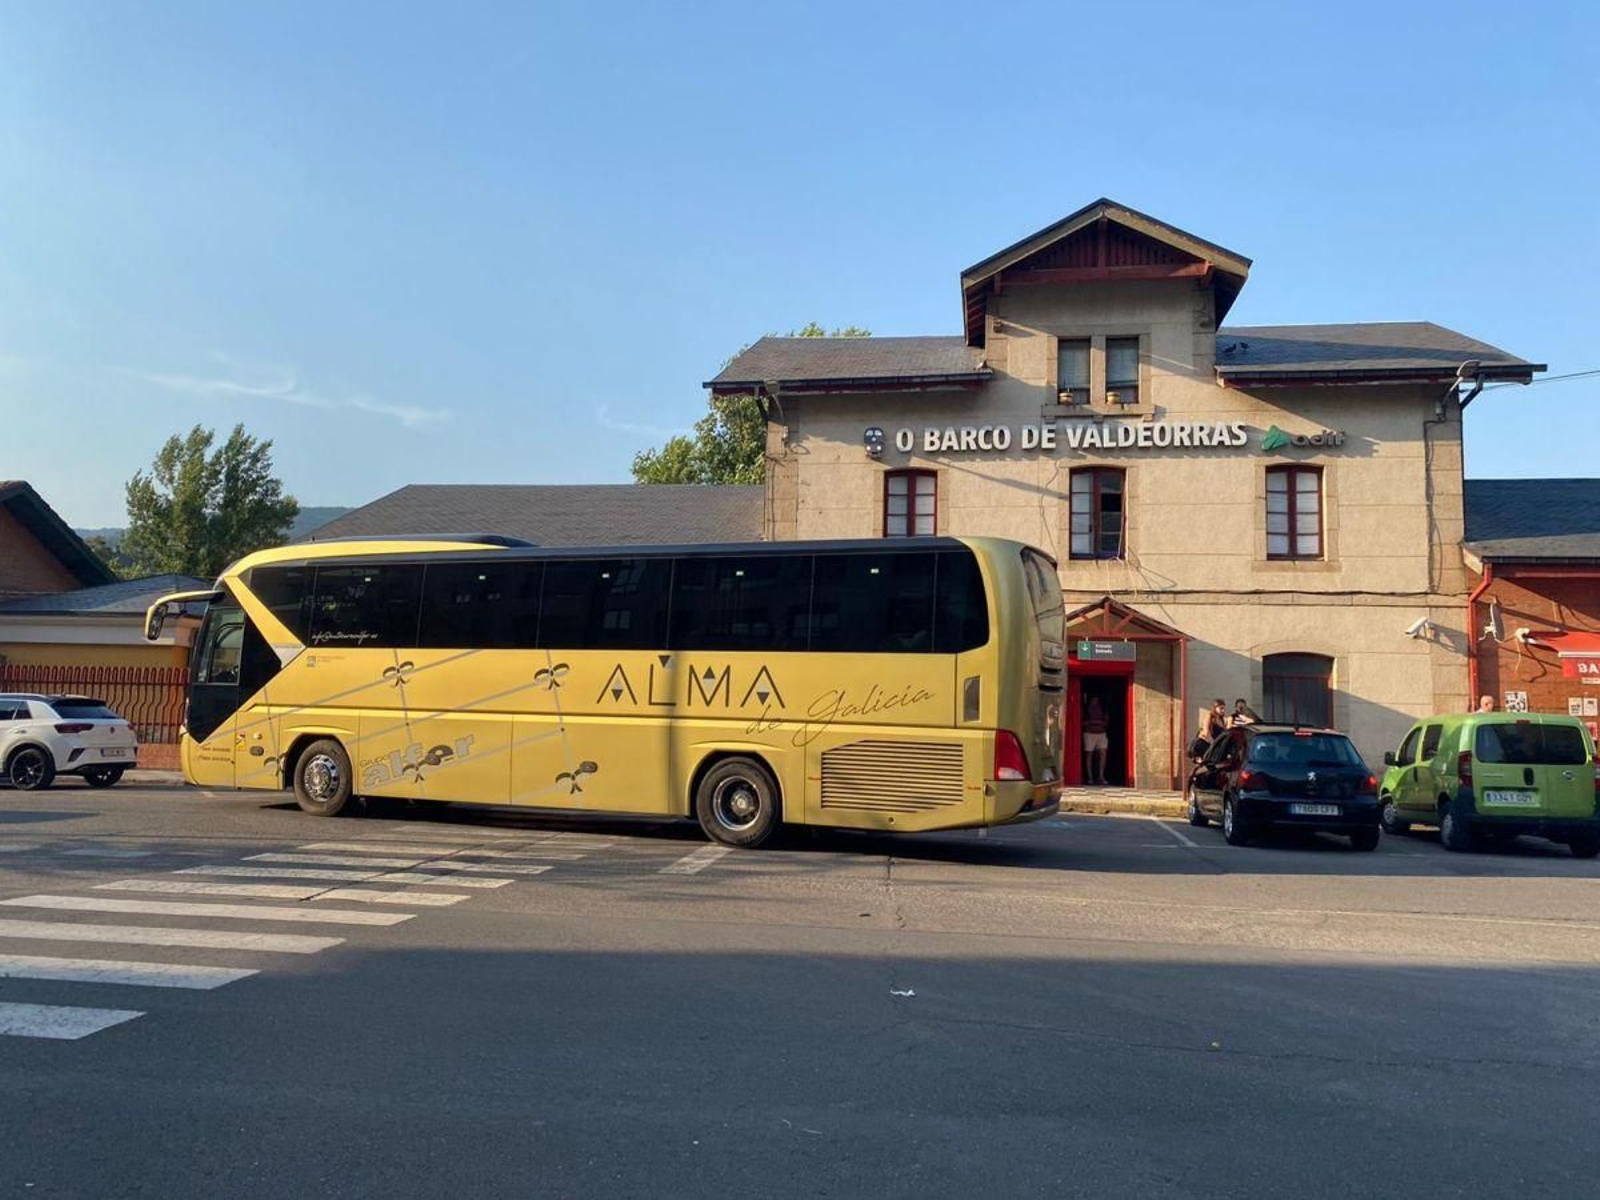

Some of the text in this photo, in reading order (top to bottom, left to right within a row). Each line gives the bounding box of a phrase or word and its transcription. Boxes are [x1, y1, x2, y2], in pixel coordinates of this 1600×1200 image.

[896, 421, 1248, 452] O BARCO DE VALDEORRAS
[596, 655, 786, 710] ALMA
[792, 684, 936, 748] Galicia
